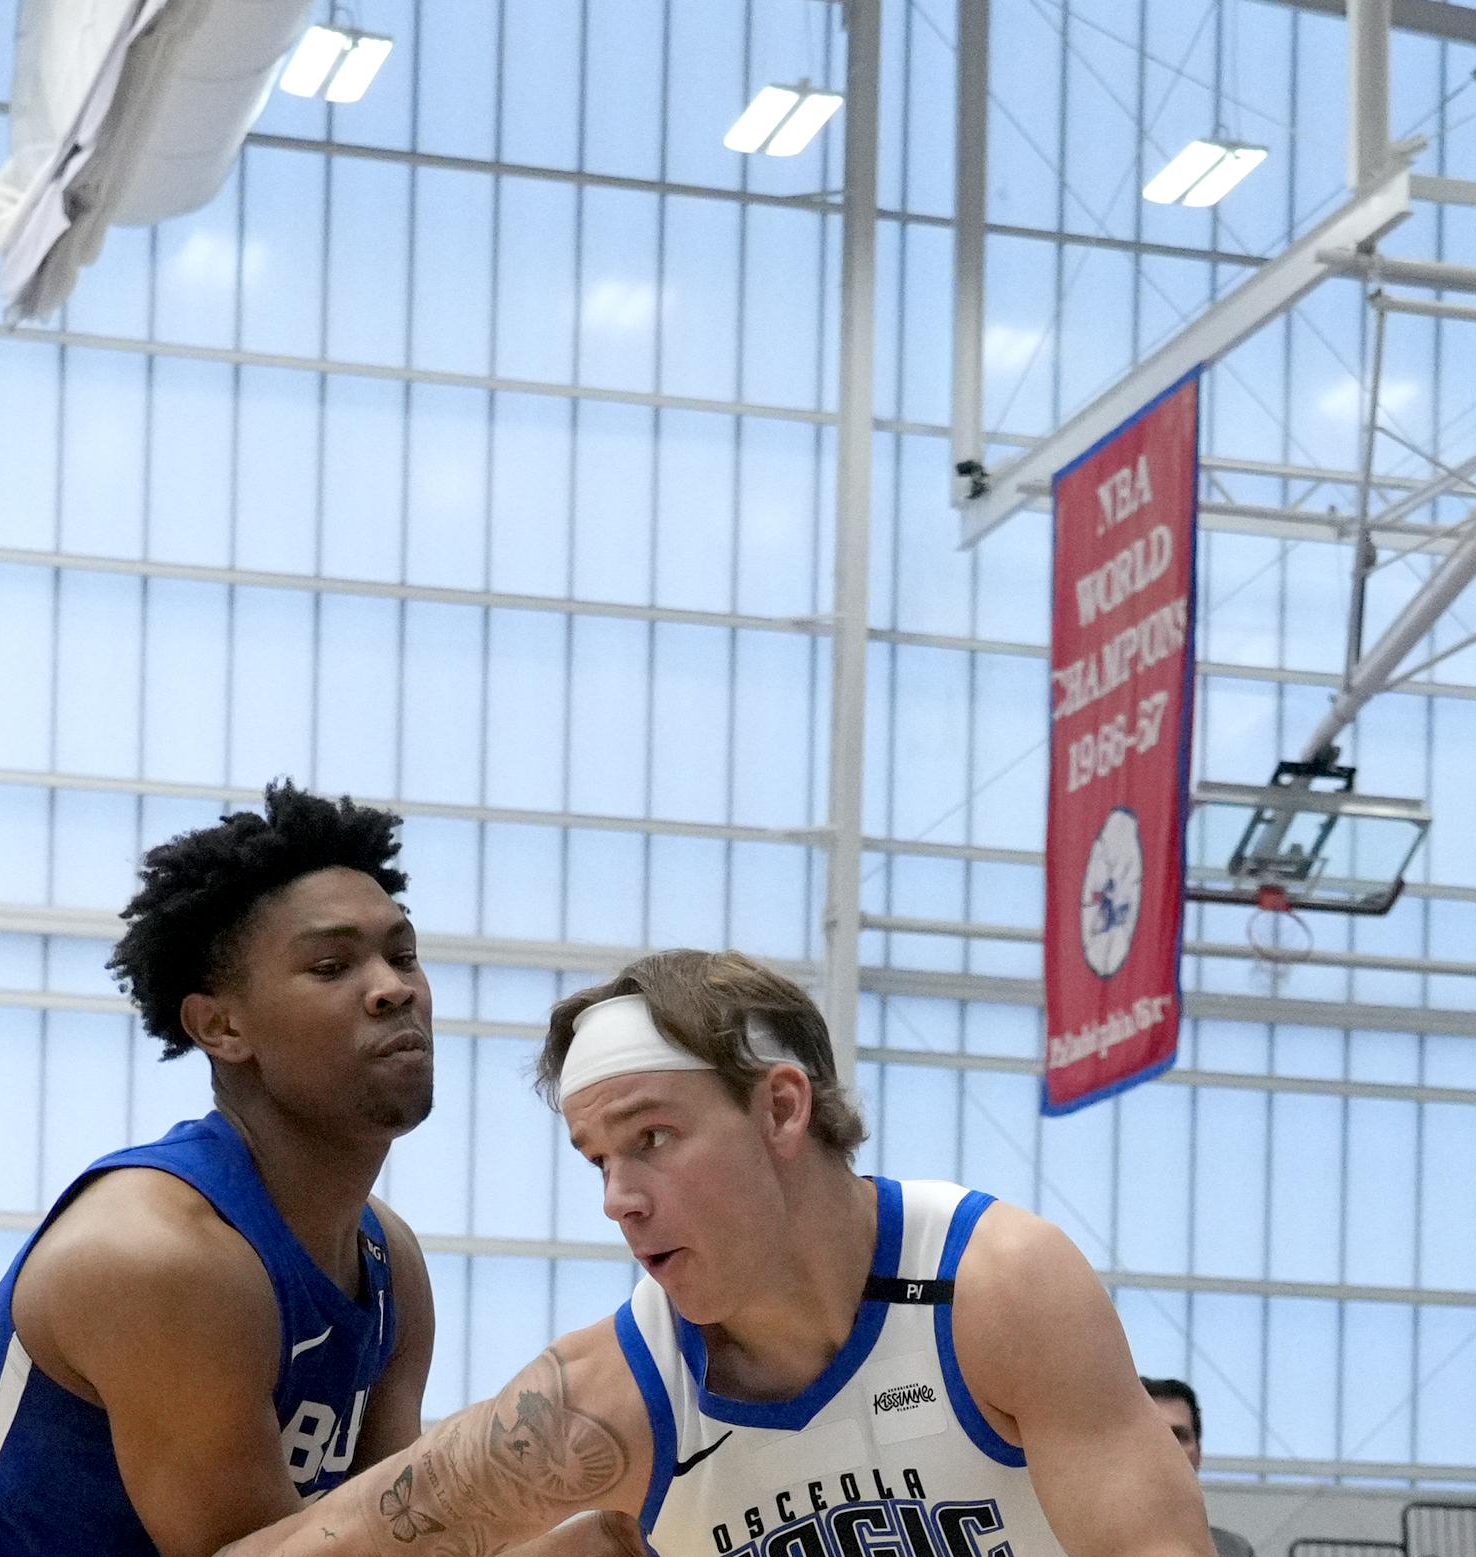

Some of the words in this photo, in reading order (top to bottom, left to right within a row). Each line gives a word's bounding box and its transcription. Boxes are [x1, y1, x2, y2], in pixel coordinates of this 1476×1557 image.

[1096, 452, 1154, 537] NBA
[1076, 523, 1174, 628] WORLD
[712, 1468, 926, 1553] OSCEOLA
